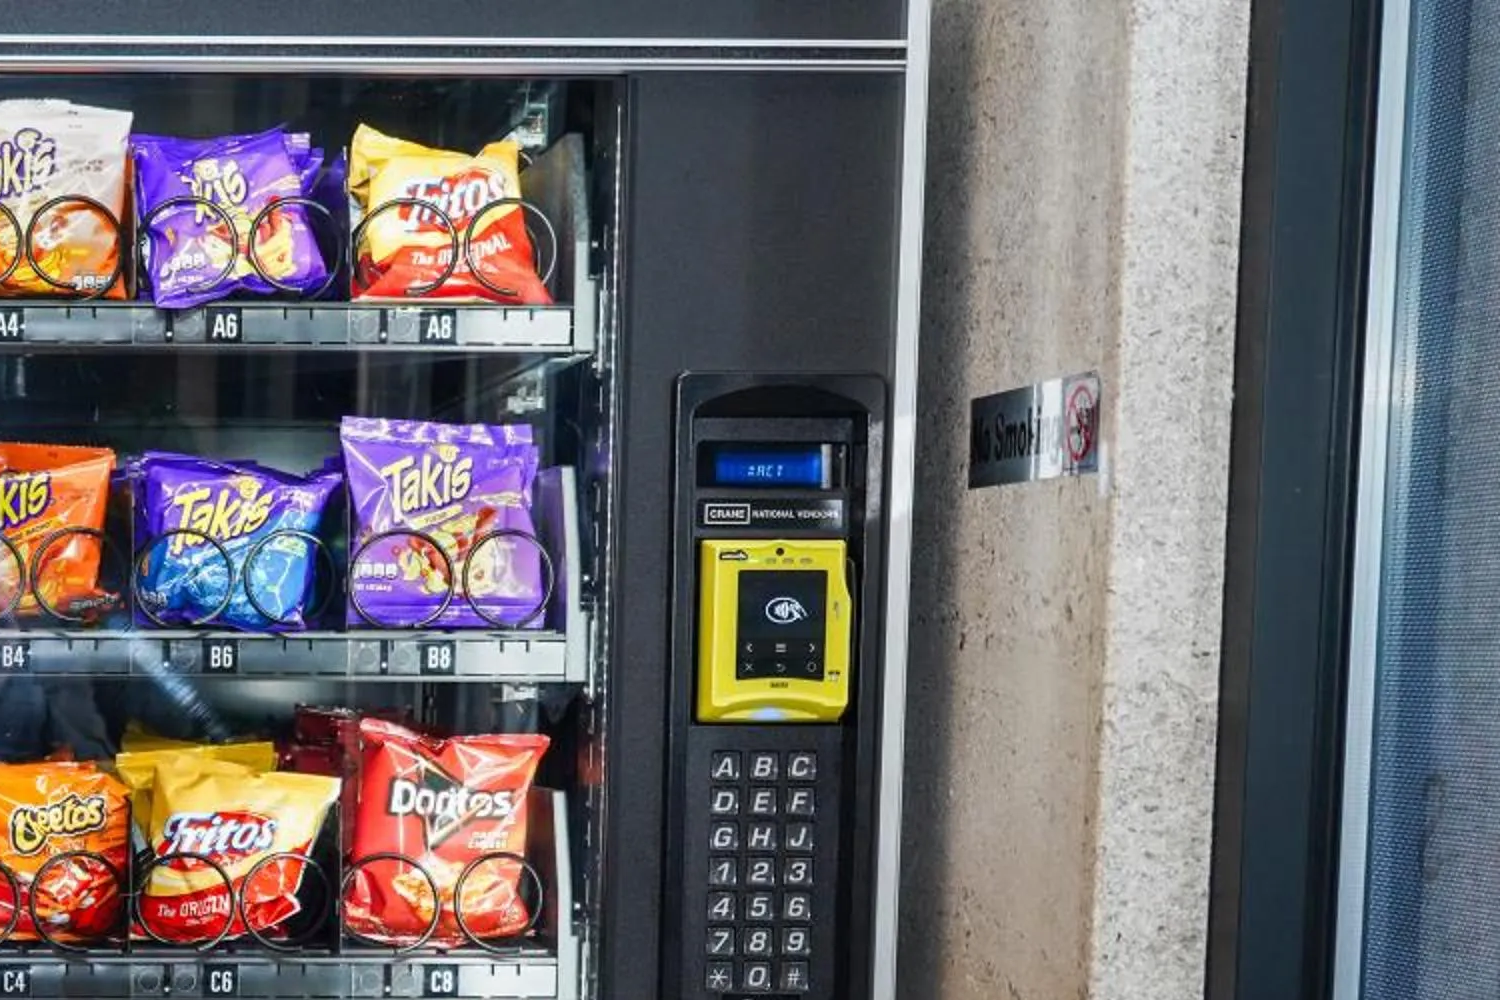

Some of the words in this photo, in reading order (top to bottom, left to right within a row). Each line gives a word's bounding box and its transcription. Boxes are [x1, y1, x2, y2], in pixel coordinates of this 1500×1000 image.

[212, 313, 238, 338] A6
[426, 315, 452, 339] A8
[381, 452, 474, 524] Takis
[169, 487, 273, 557] Takis
[709, 509, 745, 519] CRANE
[751, 509, 795, 519] NATIONAL
[3, 646, 26, 668] B4
[210, 645, 233, 668] B6
[427, 645, 451, 669] B8
[715, 757, 733, 777] A
[754, 757, 772, 777] B
[791, 757, 809, 777] C
[391, 778, 514, 817] Doritos
[714, 792, 734, 812] D
[753, 792, 770, 812] E
[790, 793, 808, 812] F
[164, 813, 277, 860] Fritos
[713, 827, 732, 847] G
[751, 827, 770, 846] H
[789, 827, 806, 847] J
[717, 863, 729, 881] 1
[751, 863, 769, 881] 2
[789, 863, 806, 881] 3
[179, 893, 231, 917] ORIGIN
[713, 897, 730, 916] 4
[750, 897, 768, 916] 5
[788, 897, 804, 916] 6
[712, 932, 729, 950] 7
[750, 931, 767, 950] 8
[787, 931, 804, 951] 9
[3, 971, 26, 992] C4
[210, 970, 233, 993] C6
[430, 970, 454, 993] C8
[749, 967, 765, 986] 0
[787, 967, 800, 985] #
